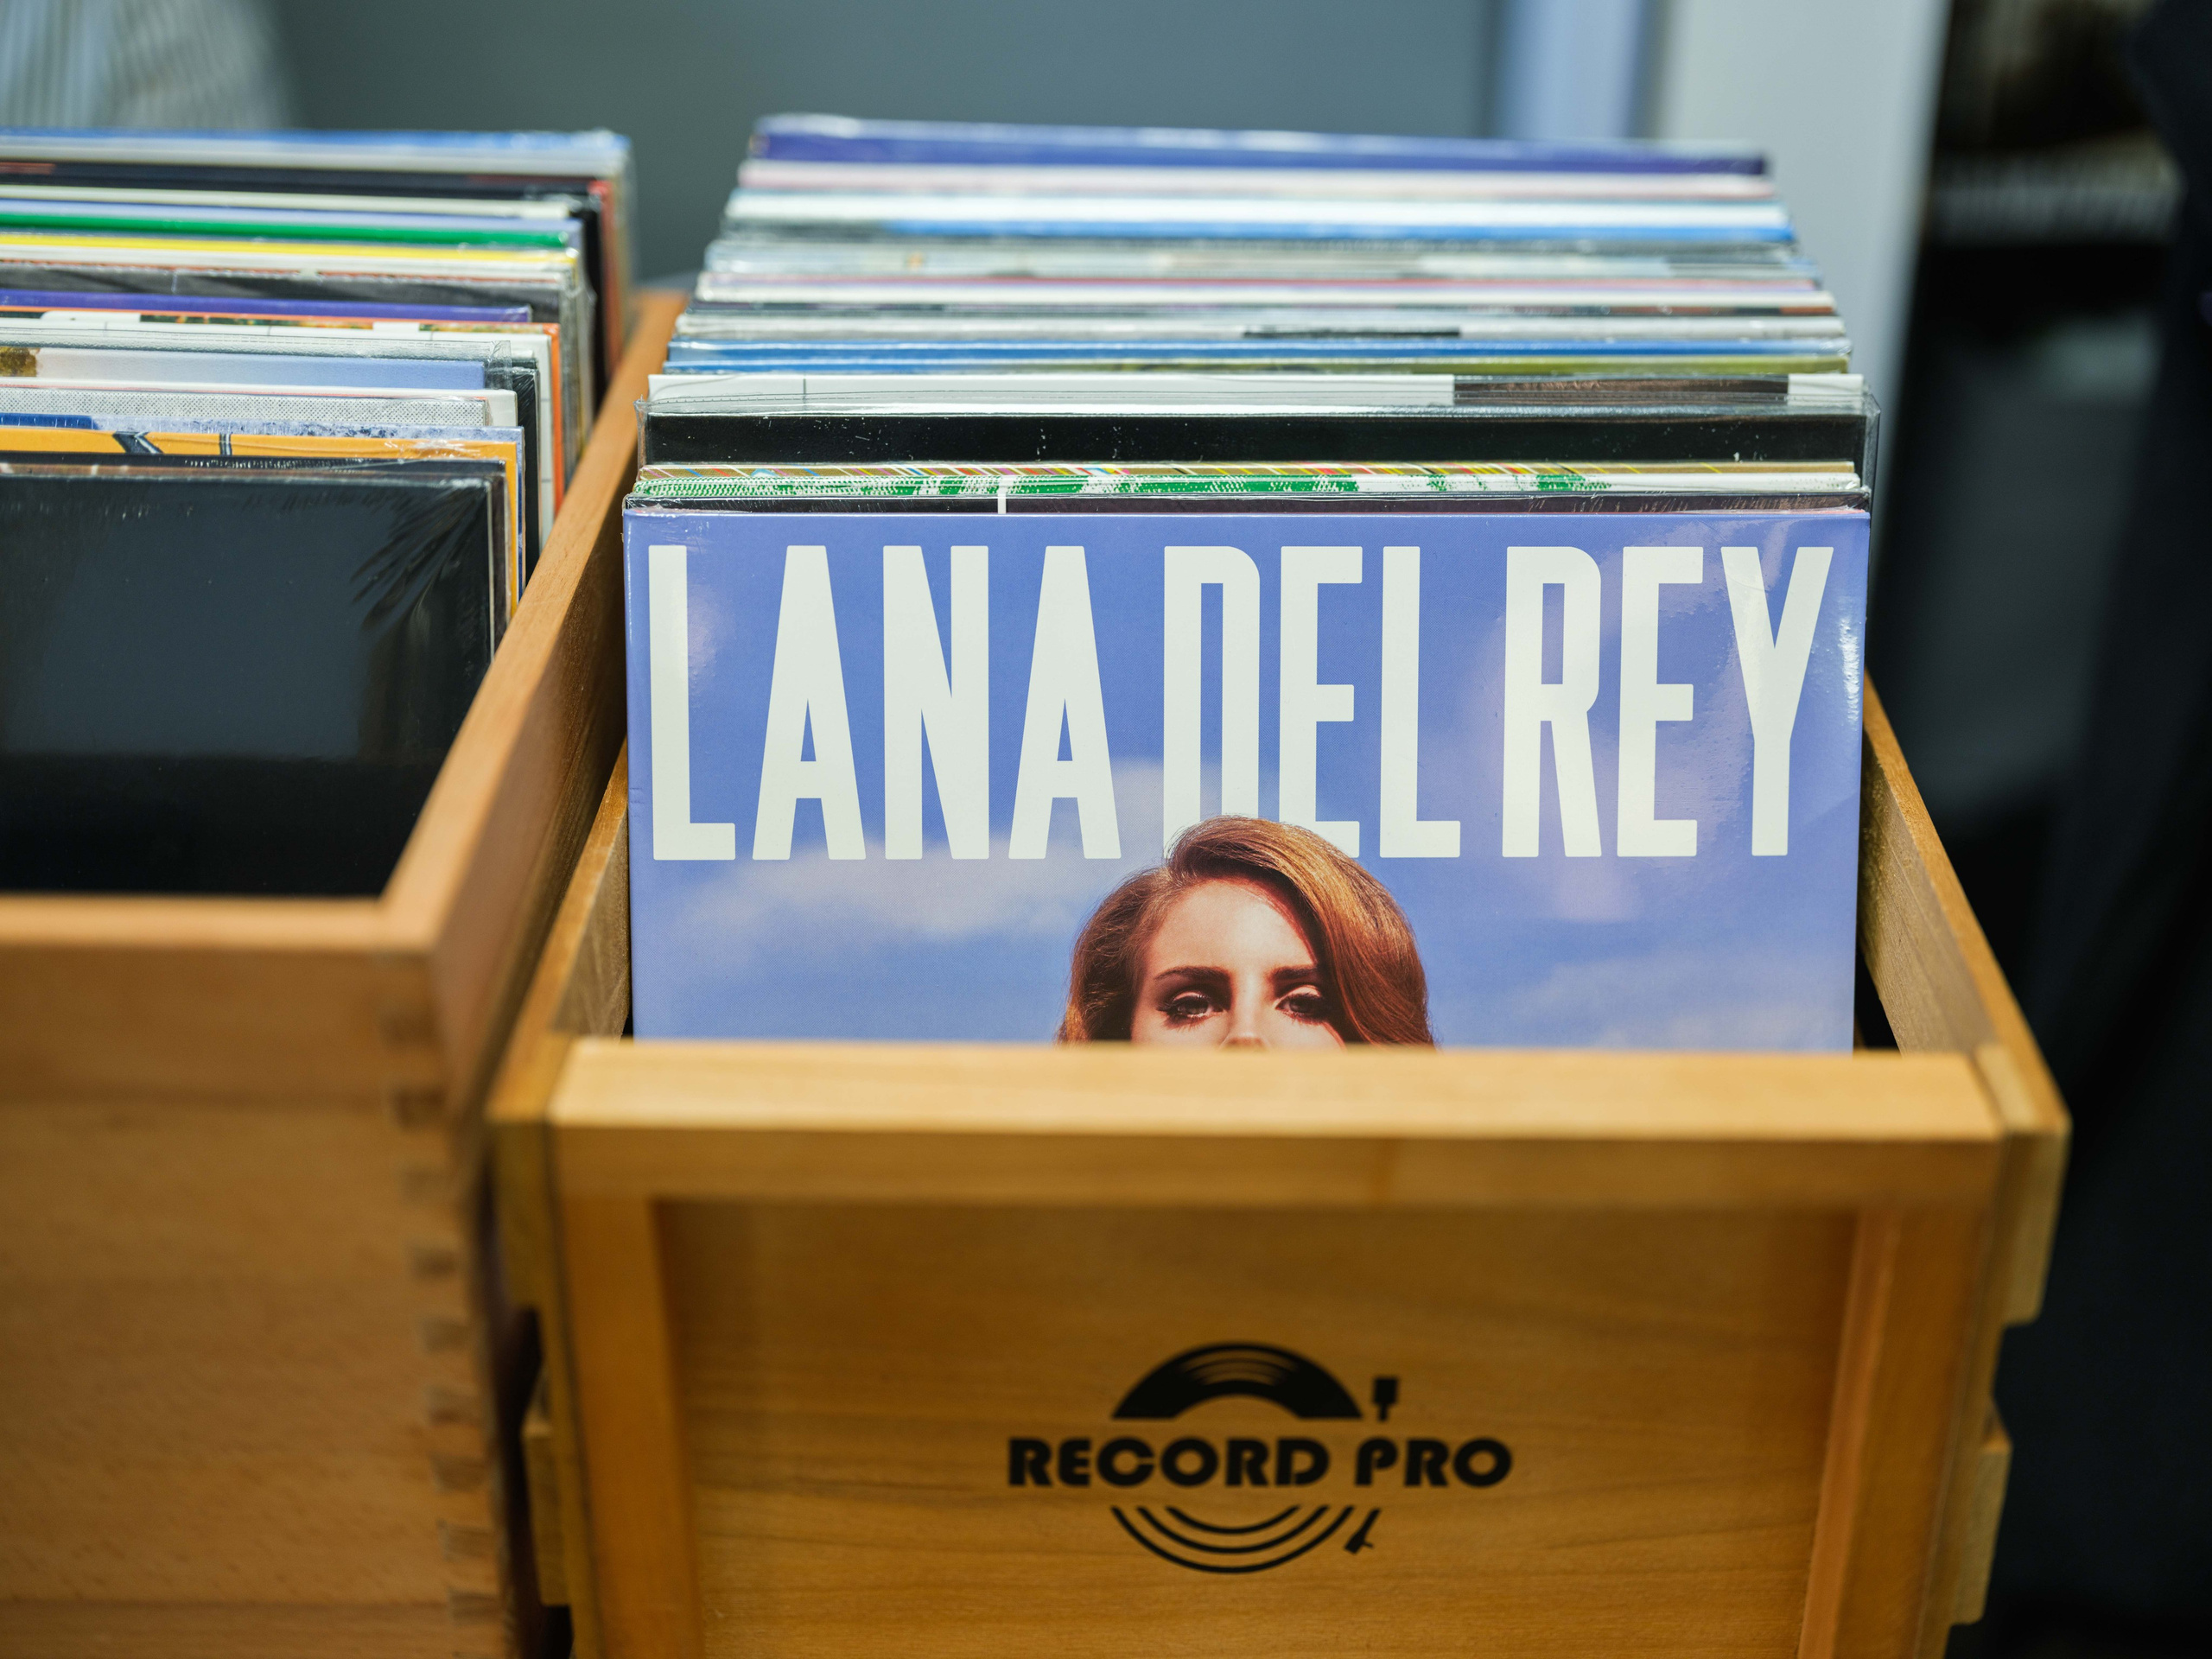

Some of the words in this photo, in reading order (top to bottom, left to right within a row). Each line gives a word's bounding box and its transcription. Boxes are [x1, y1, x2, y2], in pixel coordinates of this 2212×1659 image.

[648, 545, 1122, 861] LANA
[1163, 545, 1460, 858] DEL
[1502, 546, 1834, 858] REY
[1007, 1437, 1331, 1487] RECORD
[1354, 1437, 1514, 1487] PRO
